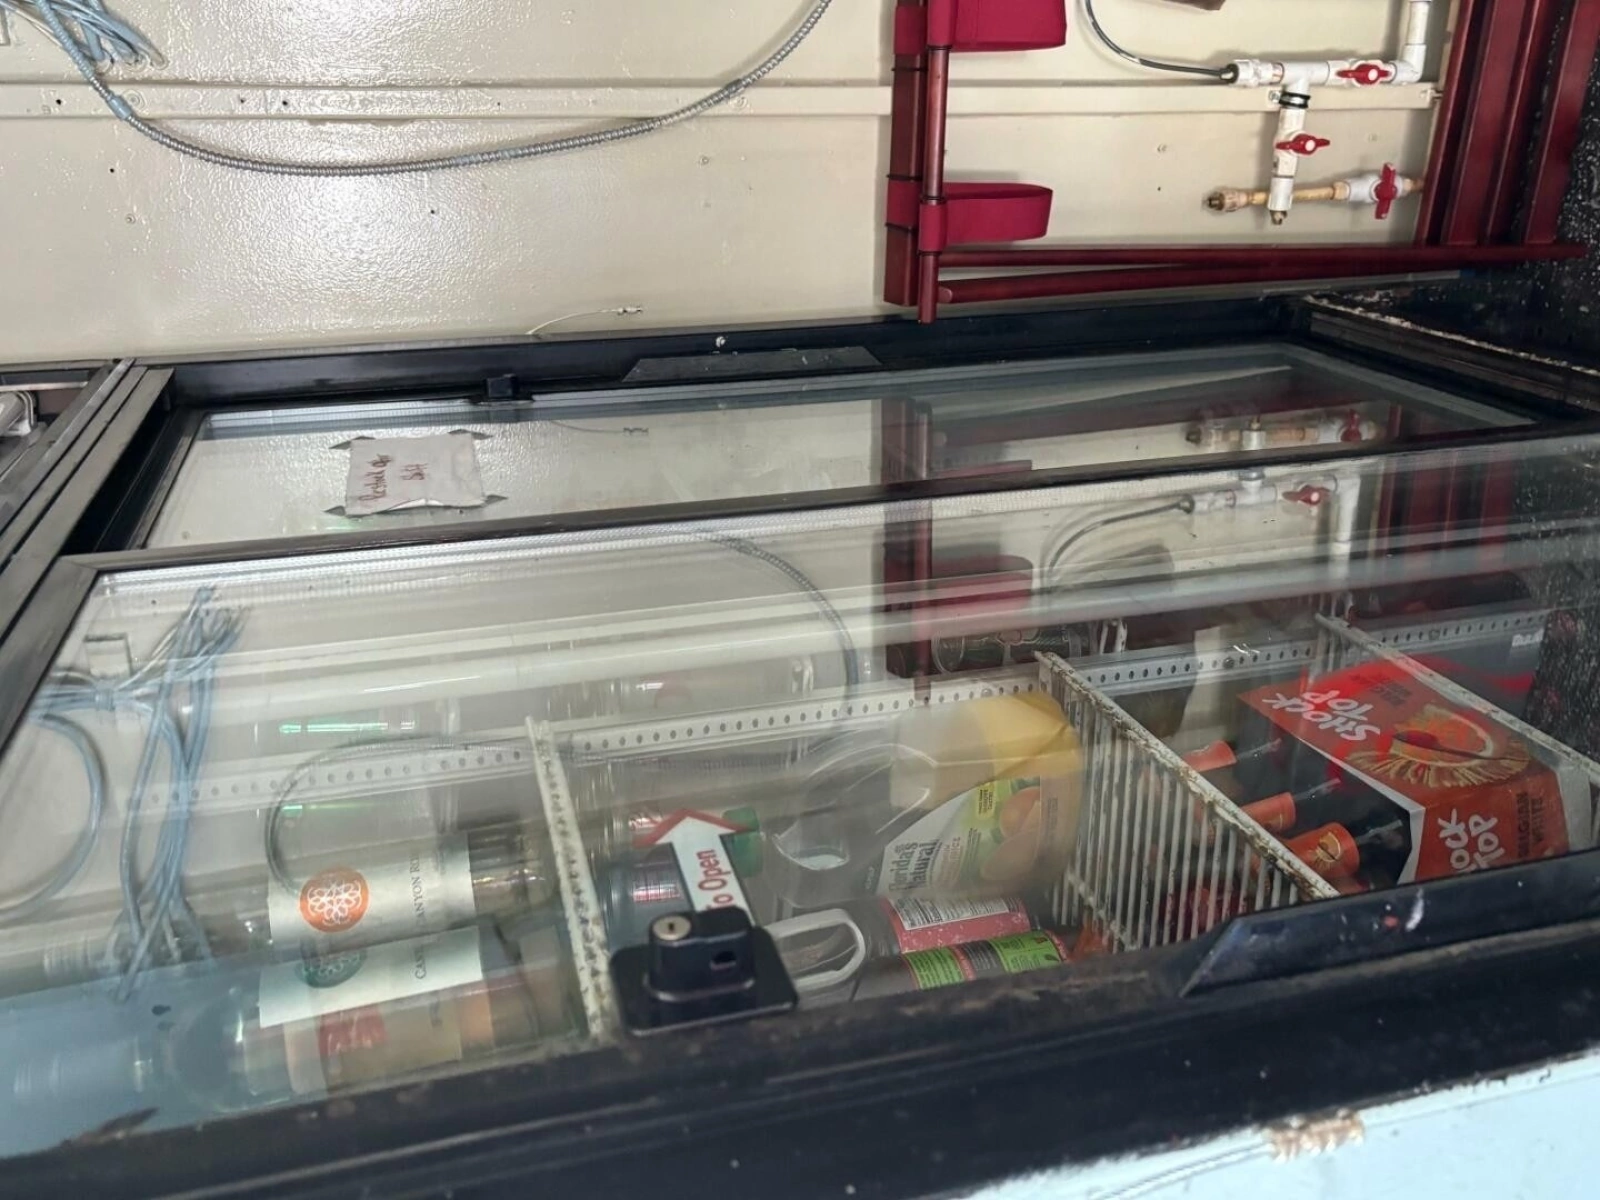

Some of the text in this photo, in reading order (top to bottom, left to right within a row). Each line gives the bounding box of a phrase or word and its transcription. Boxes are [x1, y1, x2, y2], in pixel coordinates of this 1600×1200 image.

[1262, 693, 1380, 741] SHOCK
[1302, 690, 1373, 721] TOP
[696, 849, 734, 909] o Open
